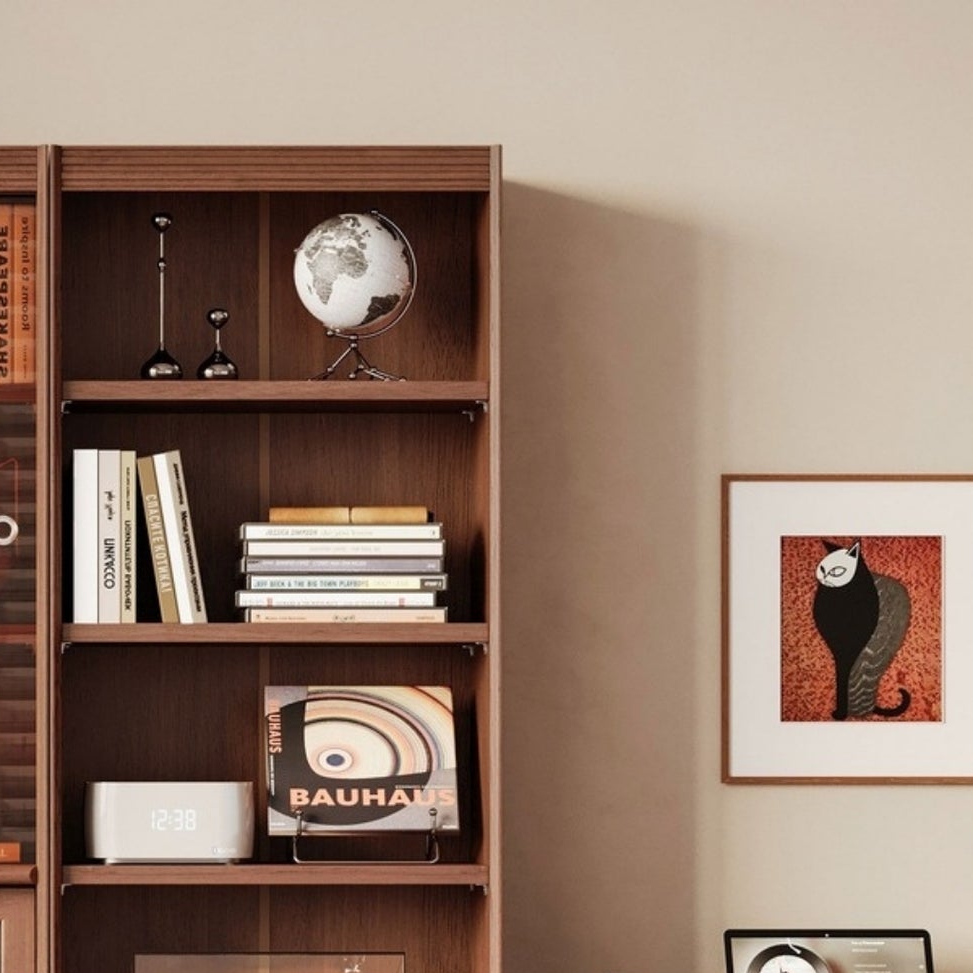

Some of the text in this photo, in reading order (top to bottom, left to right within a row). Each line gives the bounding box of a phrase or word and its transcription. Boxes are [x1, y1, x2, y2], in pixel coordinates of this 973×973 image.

[145, 494, 172, 593] СПАСИТЕ КОТИКА!
[290, 788, 455, 806] BAUHAUS
[151, 810, 197, 830] 12:38
